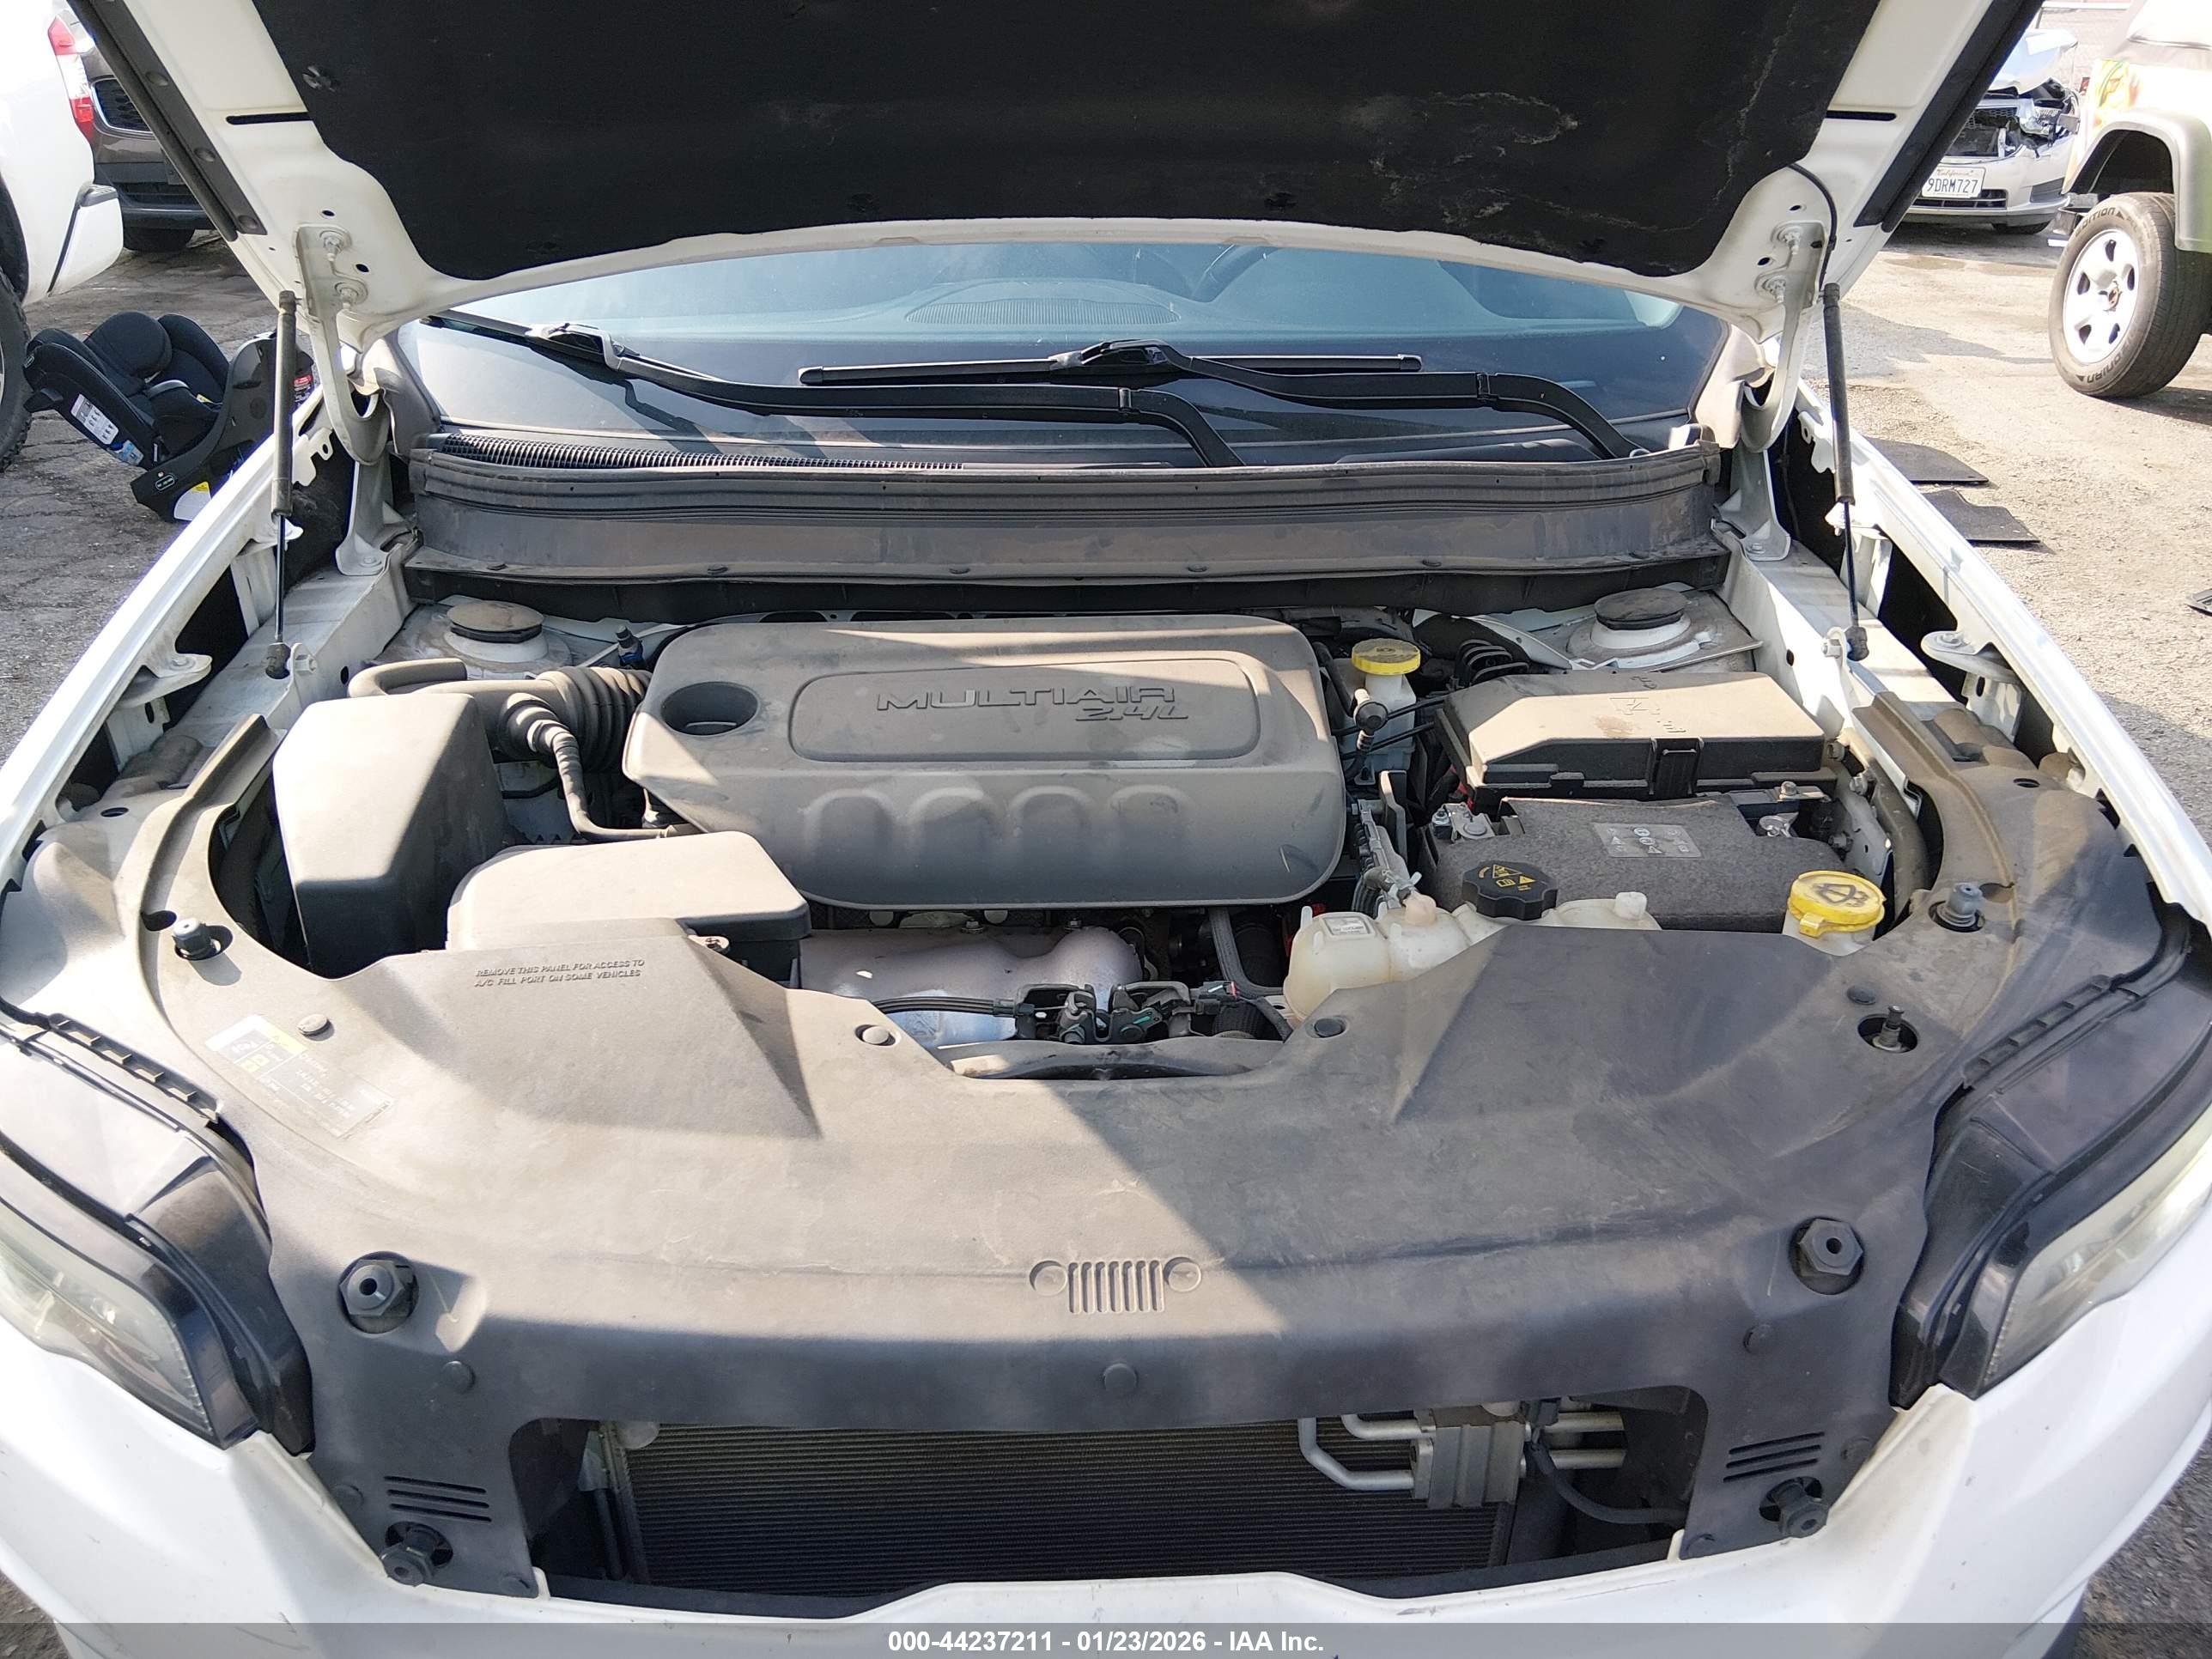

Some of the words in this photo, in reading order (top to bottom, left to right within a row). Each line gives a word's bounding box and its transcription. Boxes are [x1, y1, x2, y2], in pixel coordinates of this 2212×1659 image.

[1927, 178, 1978, 193] 9DRM727
[877, 687, 1176, 711] MULTIAIR
[1075, 706, 1189, 721] 2.4L
[476, 968, 515, 977] REMOVE
[518, 966, 539, 975] THIS
[541, 964, 571, 973] PANEL
[593, 961, 631, 969] ACCESS
[474, 979, 495, 988] A/C
[497, 977, 516, 986] FILL
[520, 975, 545, 984] PORT
[565, 972, 592, 981] SOME
[597, 969, 641, 978] VEHICLES
